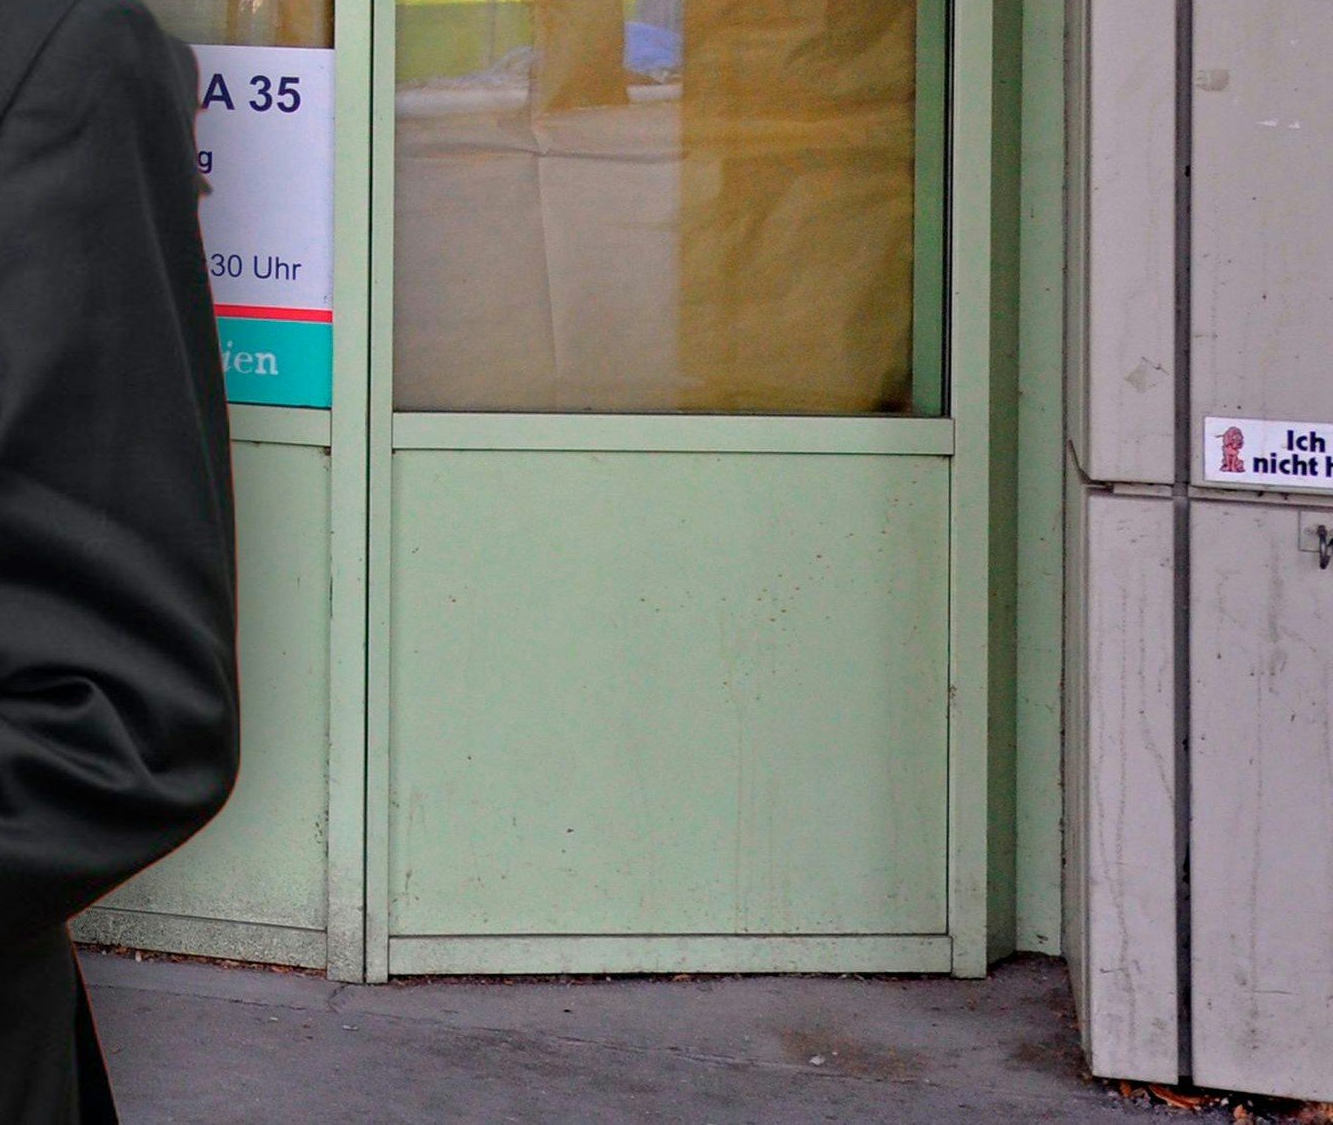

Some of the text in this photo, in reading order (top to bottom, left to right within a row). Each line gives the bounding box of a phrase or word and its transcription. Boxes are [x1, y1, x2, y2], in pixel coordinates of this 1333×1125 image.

[249, 74, 301, 113] 35
[253, 255, 302, 281] Uhr
[1286, 429, 1326, 453] Ich
[1252, 452, 1319, 477] nicht
